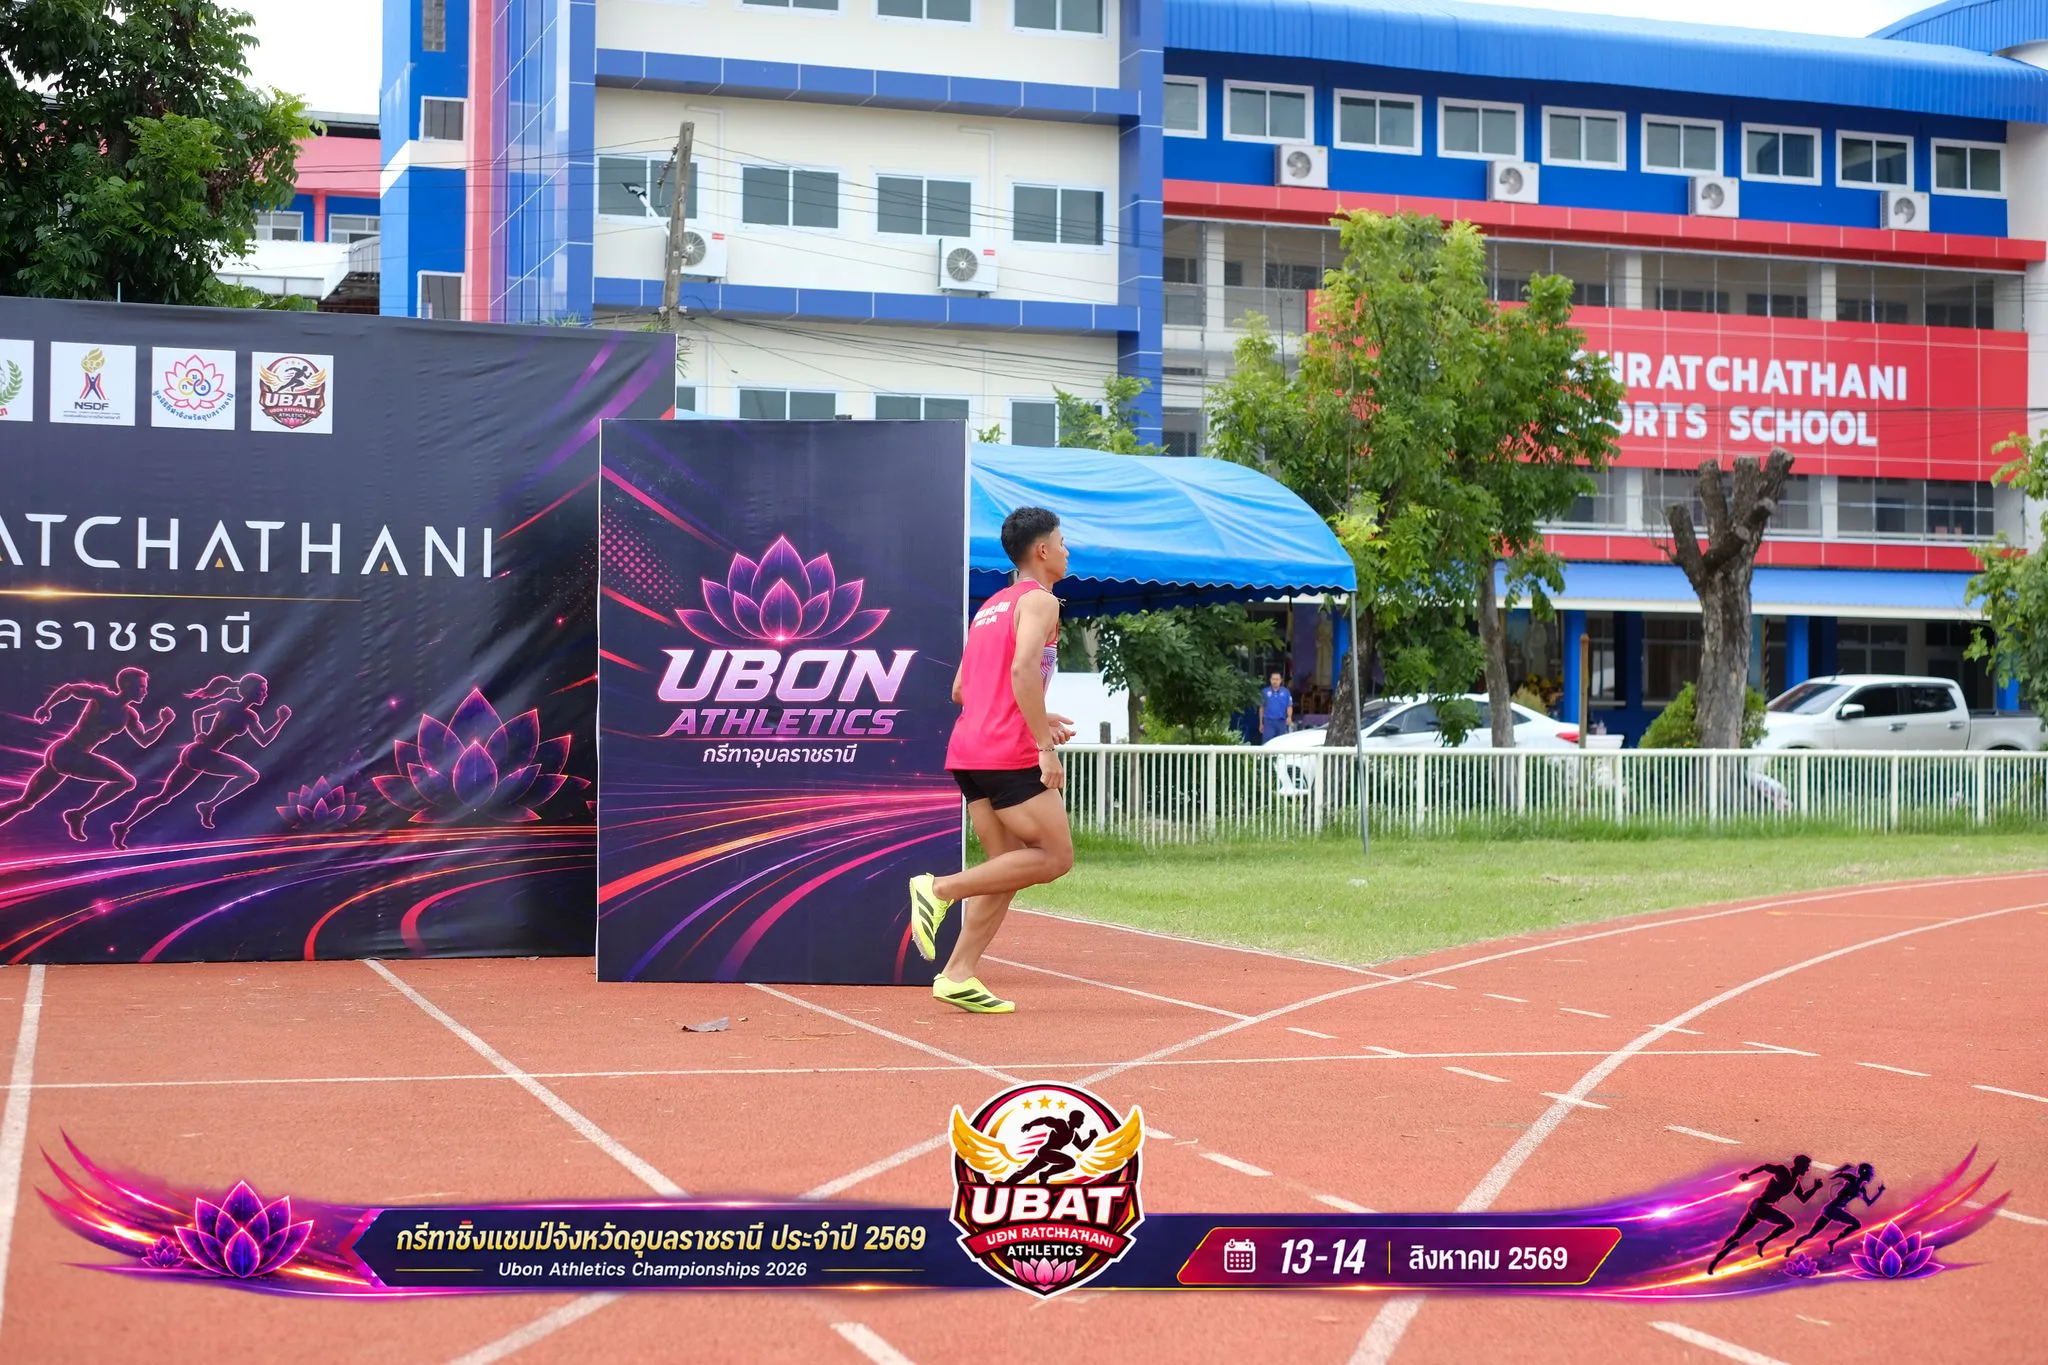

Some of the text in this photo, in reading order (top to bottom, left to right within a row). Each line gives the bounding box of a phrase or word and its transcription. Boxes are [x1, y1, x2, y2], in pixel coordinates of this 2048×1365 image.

[74, 401, 110, 411] NSDF
[264, 392, 321, 409] UBAT
[1575, 400, 1878, 447] ORTS SCHOOL
[657, 649, 919, 702] UBON
[656, 708, 904, 736] ATHLETICS
